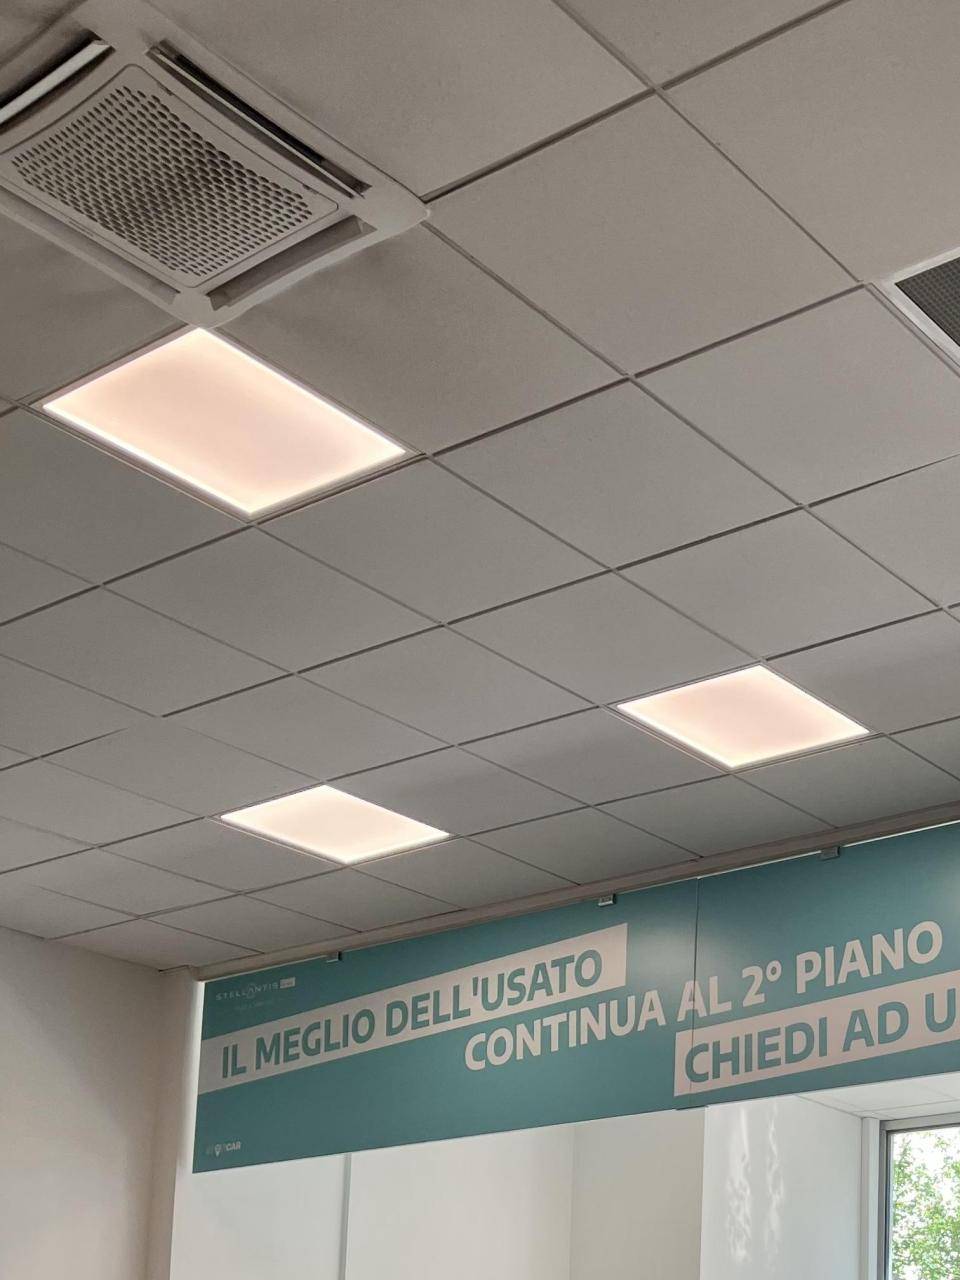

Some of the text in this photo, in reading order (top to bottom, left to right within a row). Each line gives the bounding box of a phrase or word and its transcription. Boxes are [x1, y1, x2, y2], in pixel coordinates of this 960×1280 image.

[222, 949, 603, 1080] IL MEGLIO DELL'USATO
[465, 989, 666, 1071] CONTINUA
[677, 976, 732, 1022] AL
[796, 920, 944, 994] PIANO
[684, 1016, 828, 1083] CHIEDI
[842, 1001, 909, 1052] AD
